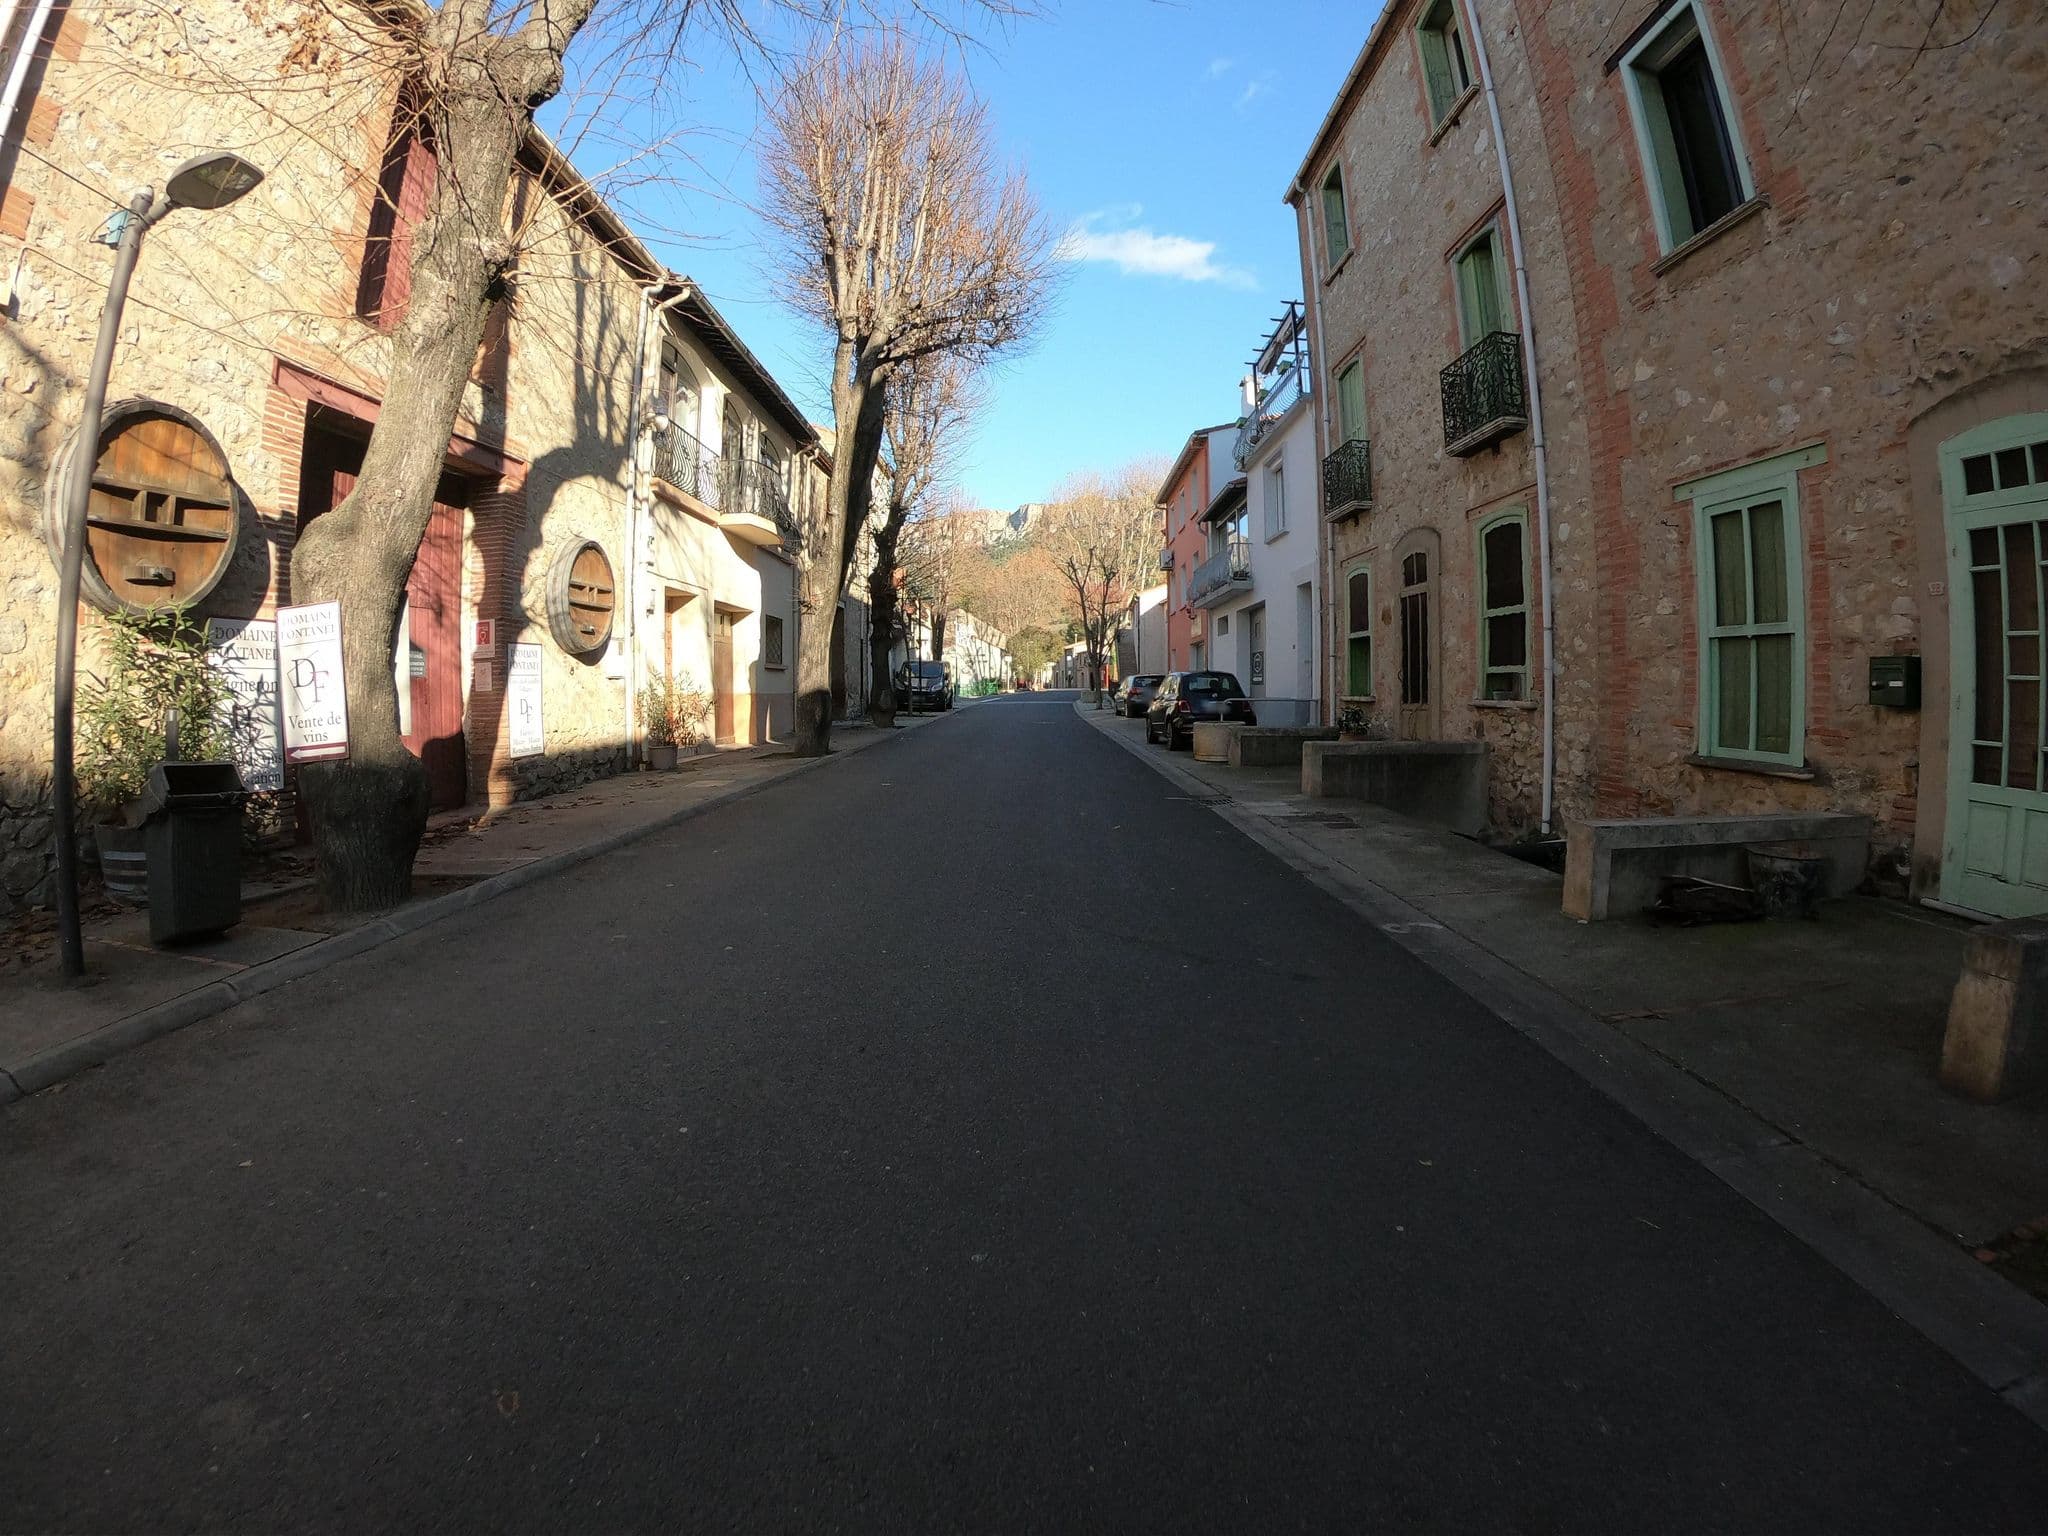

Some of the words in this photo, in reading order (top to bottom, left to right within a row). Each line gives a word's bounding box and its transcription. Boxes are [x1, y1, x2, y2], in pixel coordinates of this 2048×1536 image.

[215, 626, 277, 642] DOMAINE
[225, 679, 278, 694] igneron
[288, 714, 324, 729] Vente
[327, 711, 341, 726] de
[303, 729, 328, 744] vins
